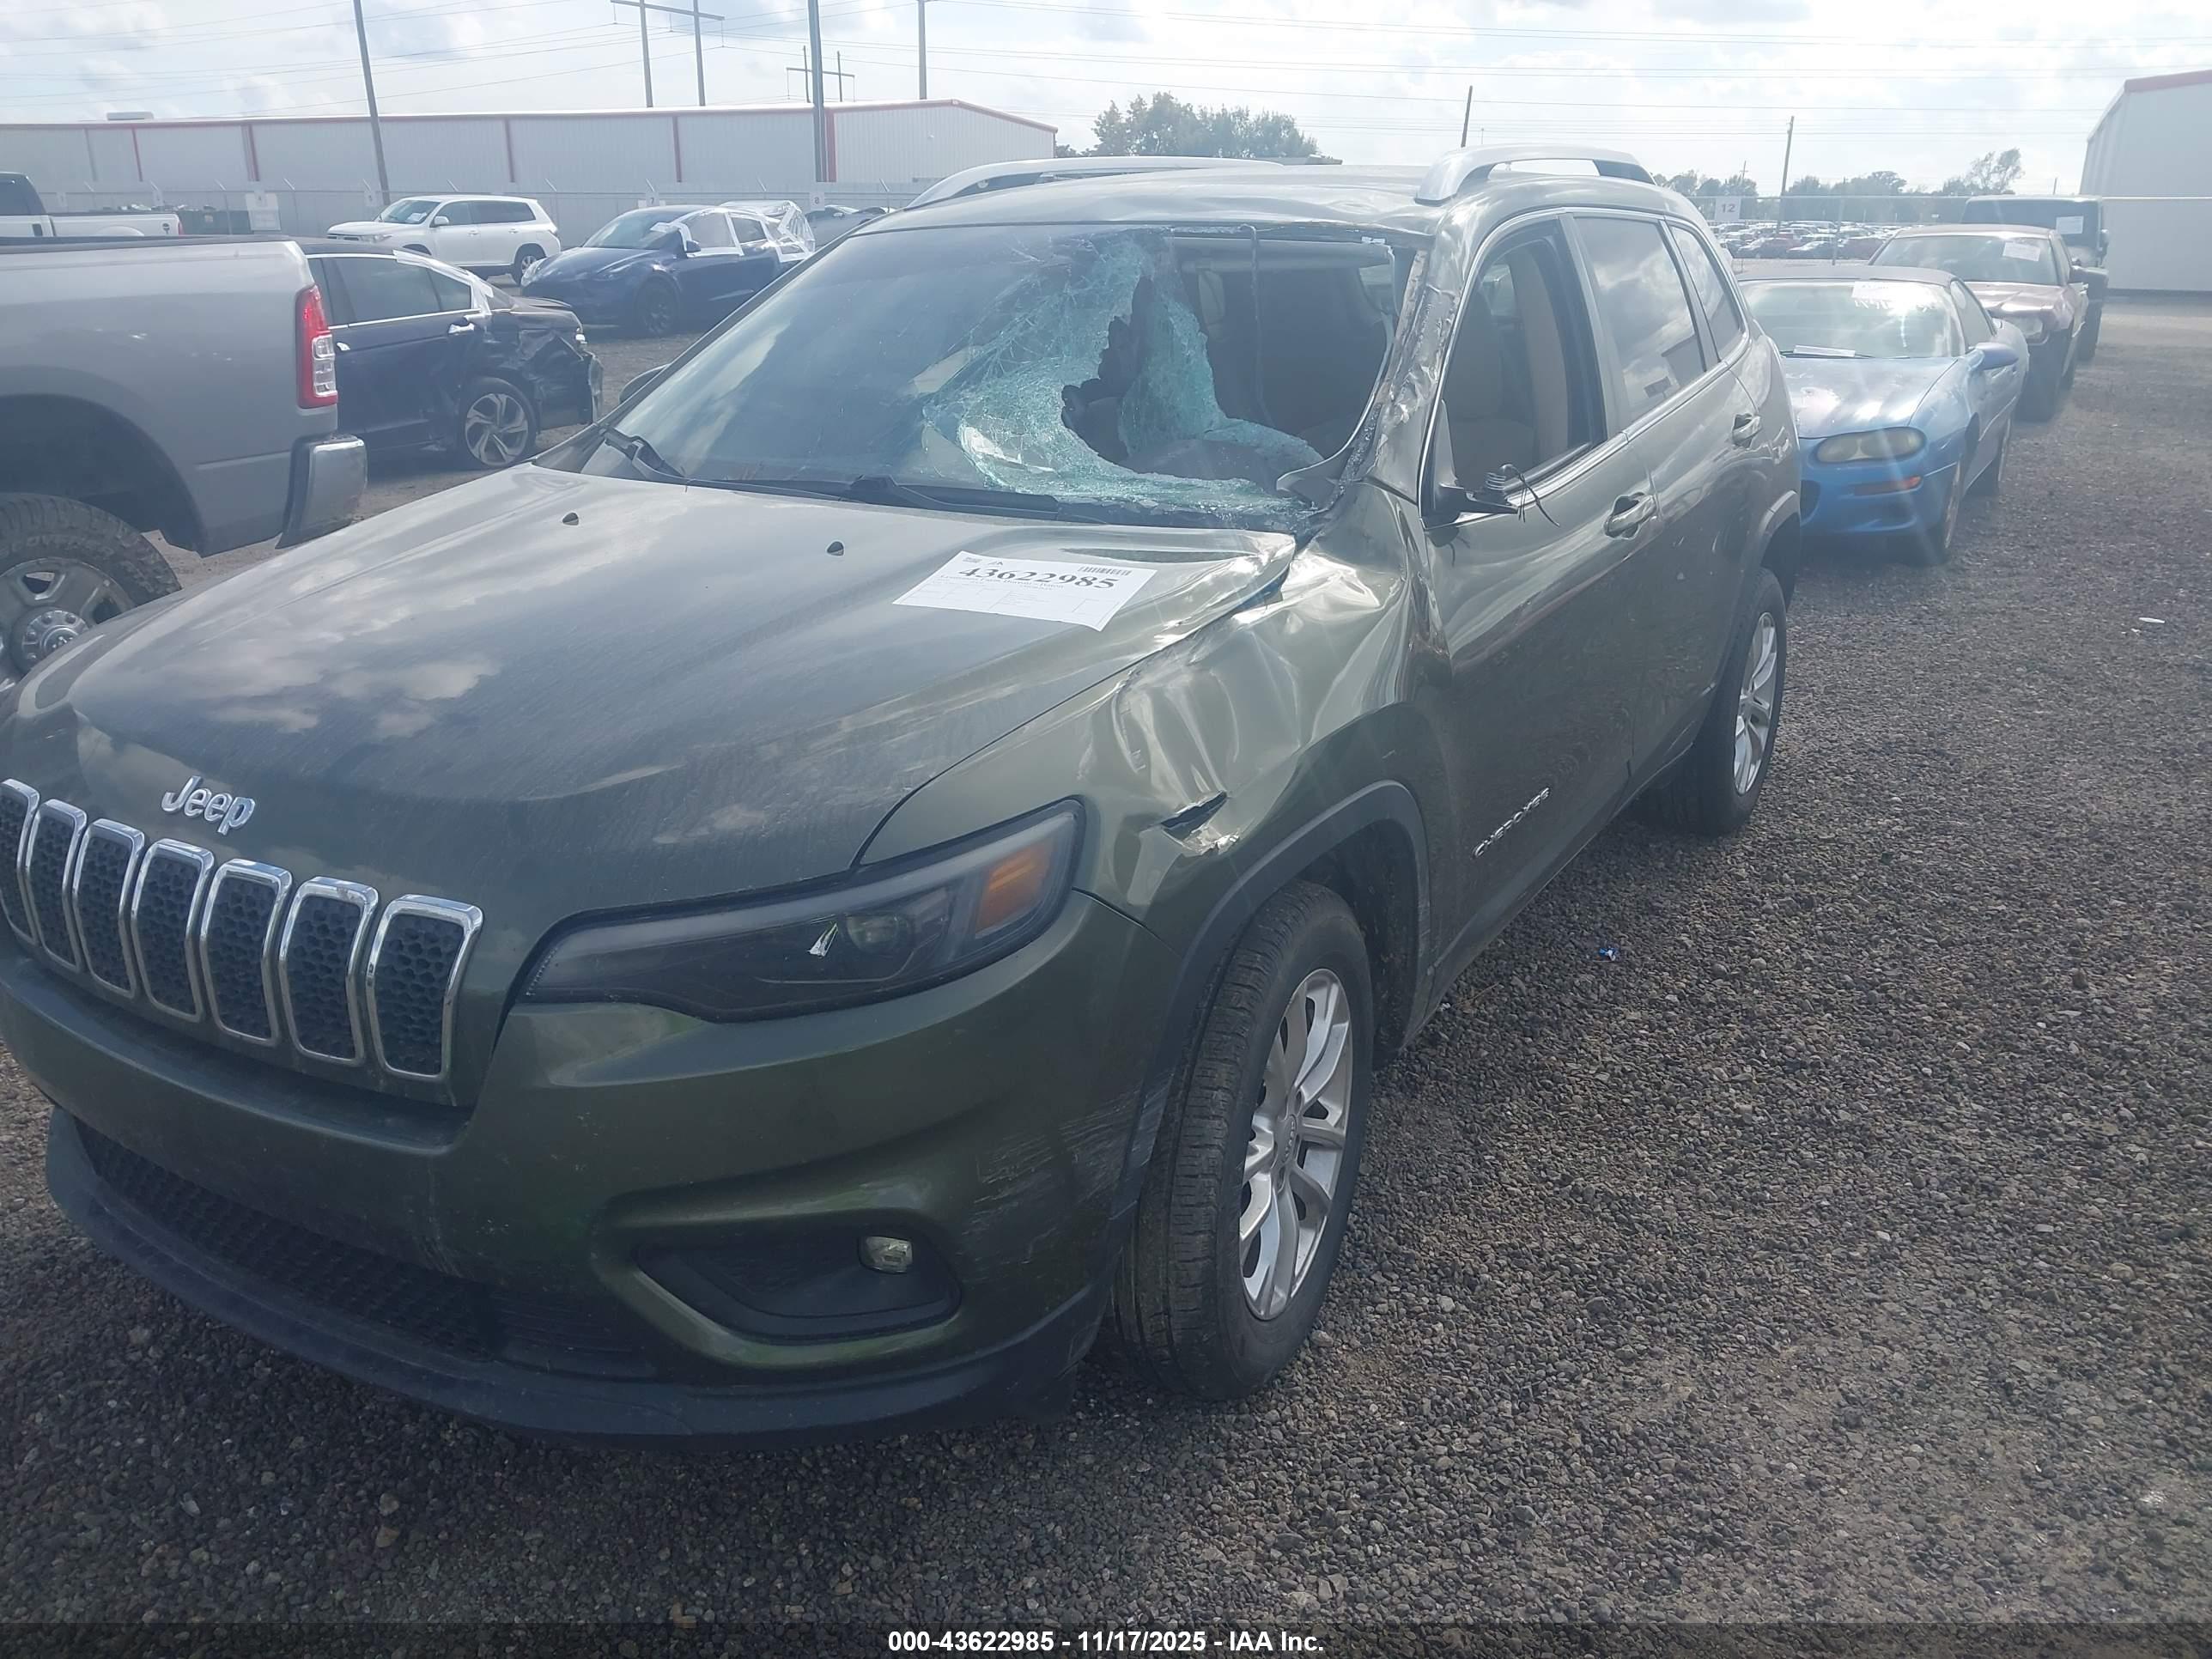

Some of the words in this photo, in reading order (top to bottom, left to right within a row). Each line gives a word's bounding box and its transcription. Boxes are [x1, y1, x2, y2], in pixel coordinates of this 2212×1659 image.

[1721, 203, 1736, 214] 12
[958, 567, 1119, 589] 43622985
[161, 775, 256, 836] Jeep
